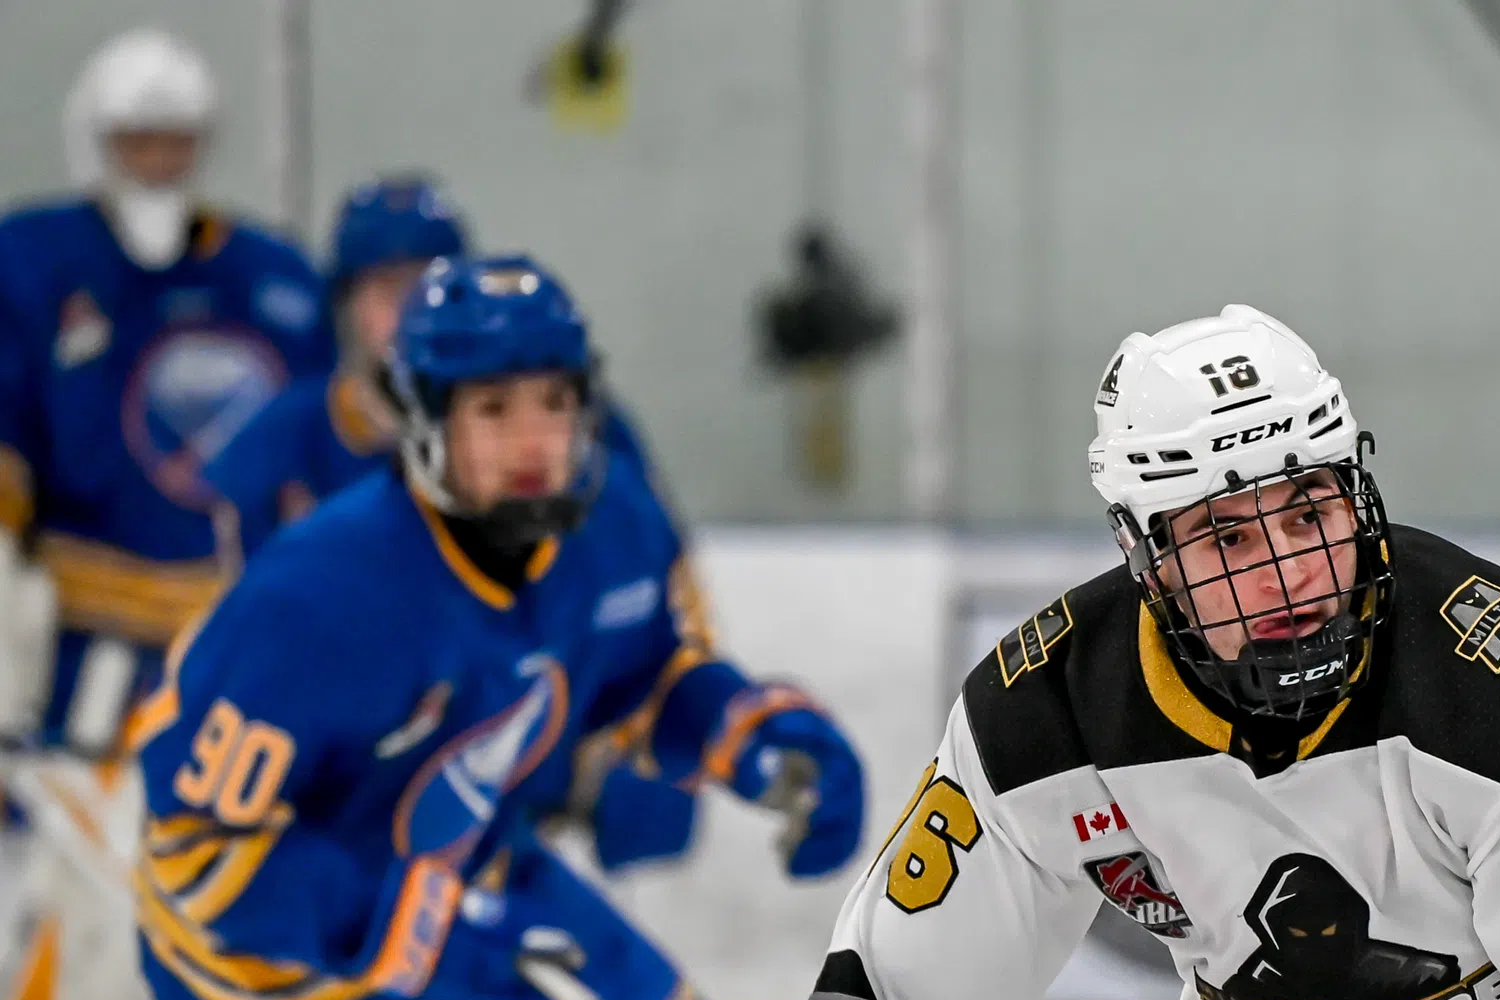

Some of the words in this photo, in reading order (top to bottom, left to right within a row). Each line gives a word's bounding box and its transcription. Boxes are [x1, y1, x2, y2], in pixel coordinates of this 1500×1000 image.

[1210, 416, 1294, 453] CCM
[1277, 653, 1350, 687] CCM
[174, 698, 296, 827] 90
[867, 756, 985, 916] 6
